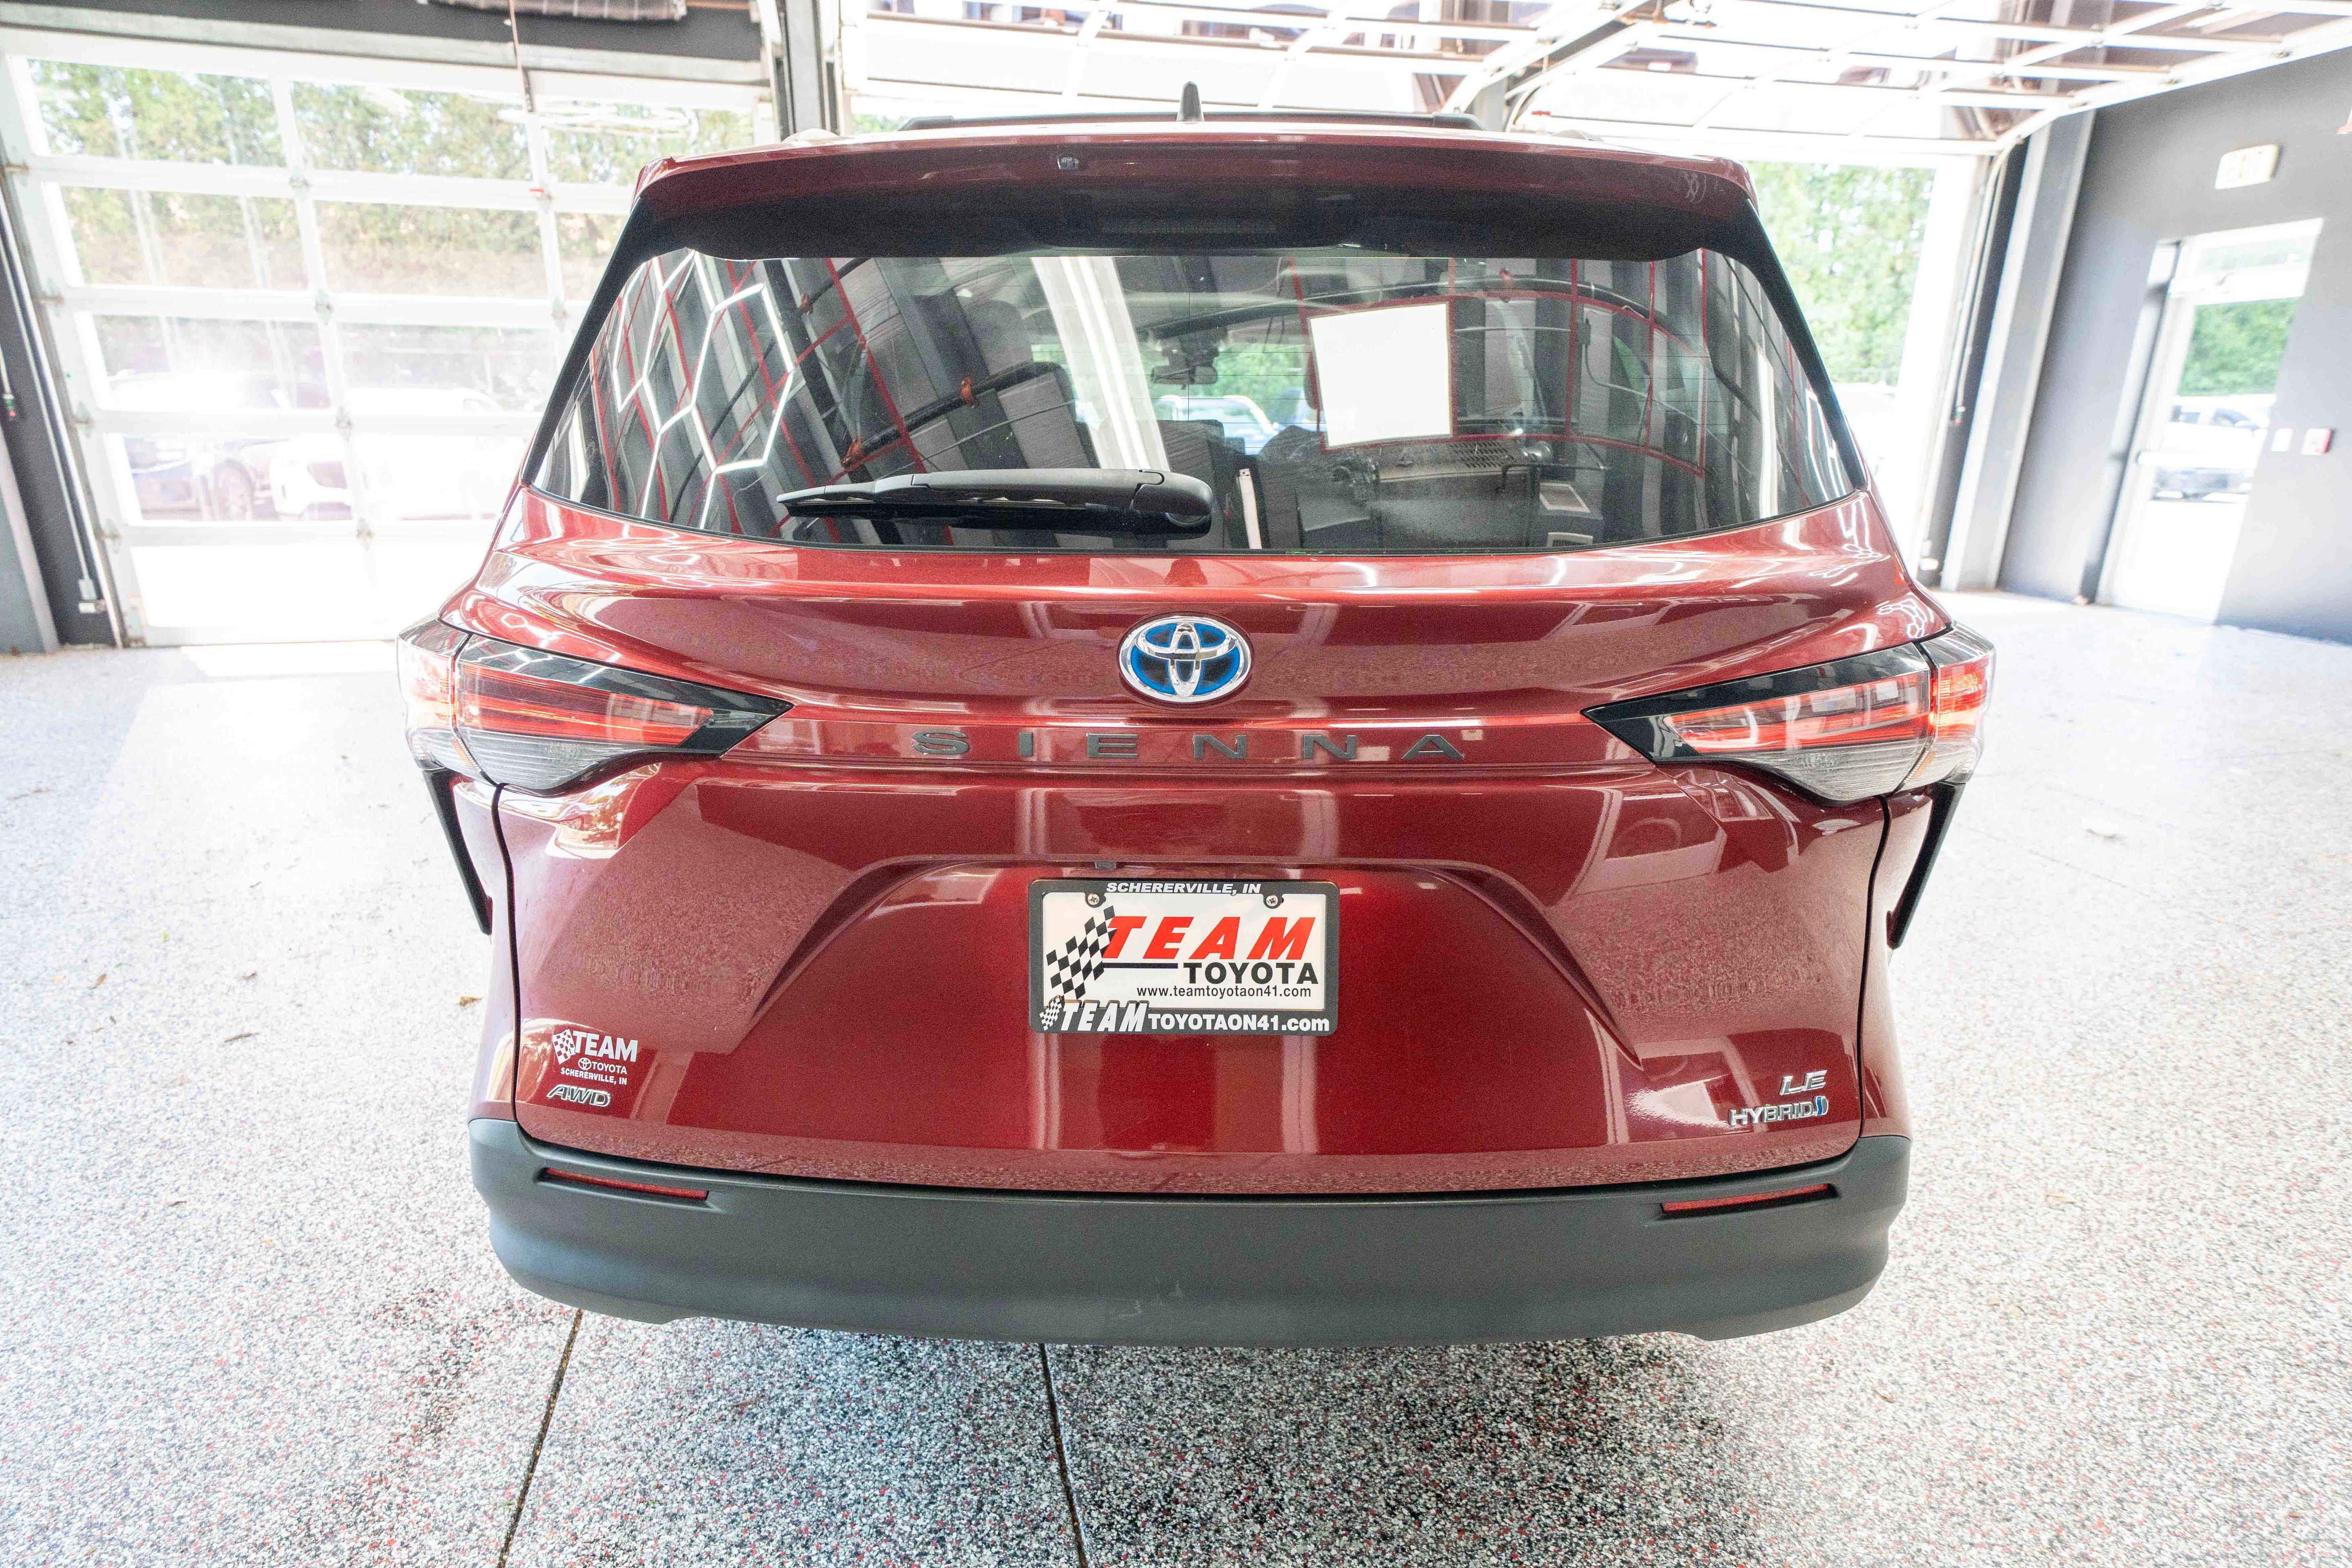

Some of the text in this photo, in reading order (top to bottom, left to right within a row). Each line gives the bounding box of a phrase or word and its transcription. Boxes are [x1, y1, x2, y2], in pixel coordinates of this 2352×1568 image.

[911, 729, 1465, 761] SIENNA
[1106, 882, 1261, 896] SCHERERVILLE, IN
[1102, 916, 1316, 960] TEAM
[1183, 962, 1318, 984] TOYOTA
[1137, 985, 1312, 998] www.teamtoyotaon41.com
[1060, 1002, 1330, 1032] TEAM TOYOTAON41.com
[573, 1030, 638, 1062] TEAM
[561, 1067, 617, 1085] SCHERERVILLE,
[592, 1061, 627, 1074] TOYOTA
[1779, 1070, 1827, 1096] LE
[546, 1084, 611, 1107] AWD
[1729, 1101, 1814, 1126] HYBRID
